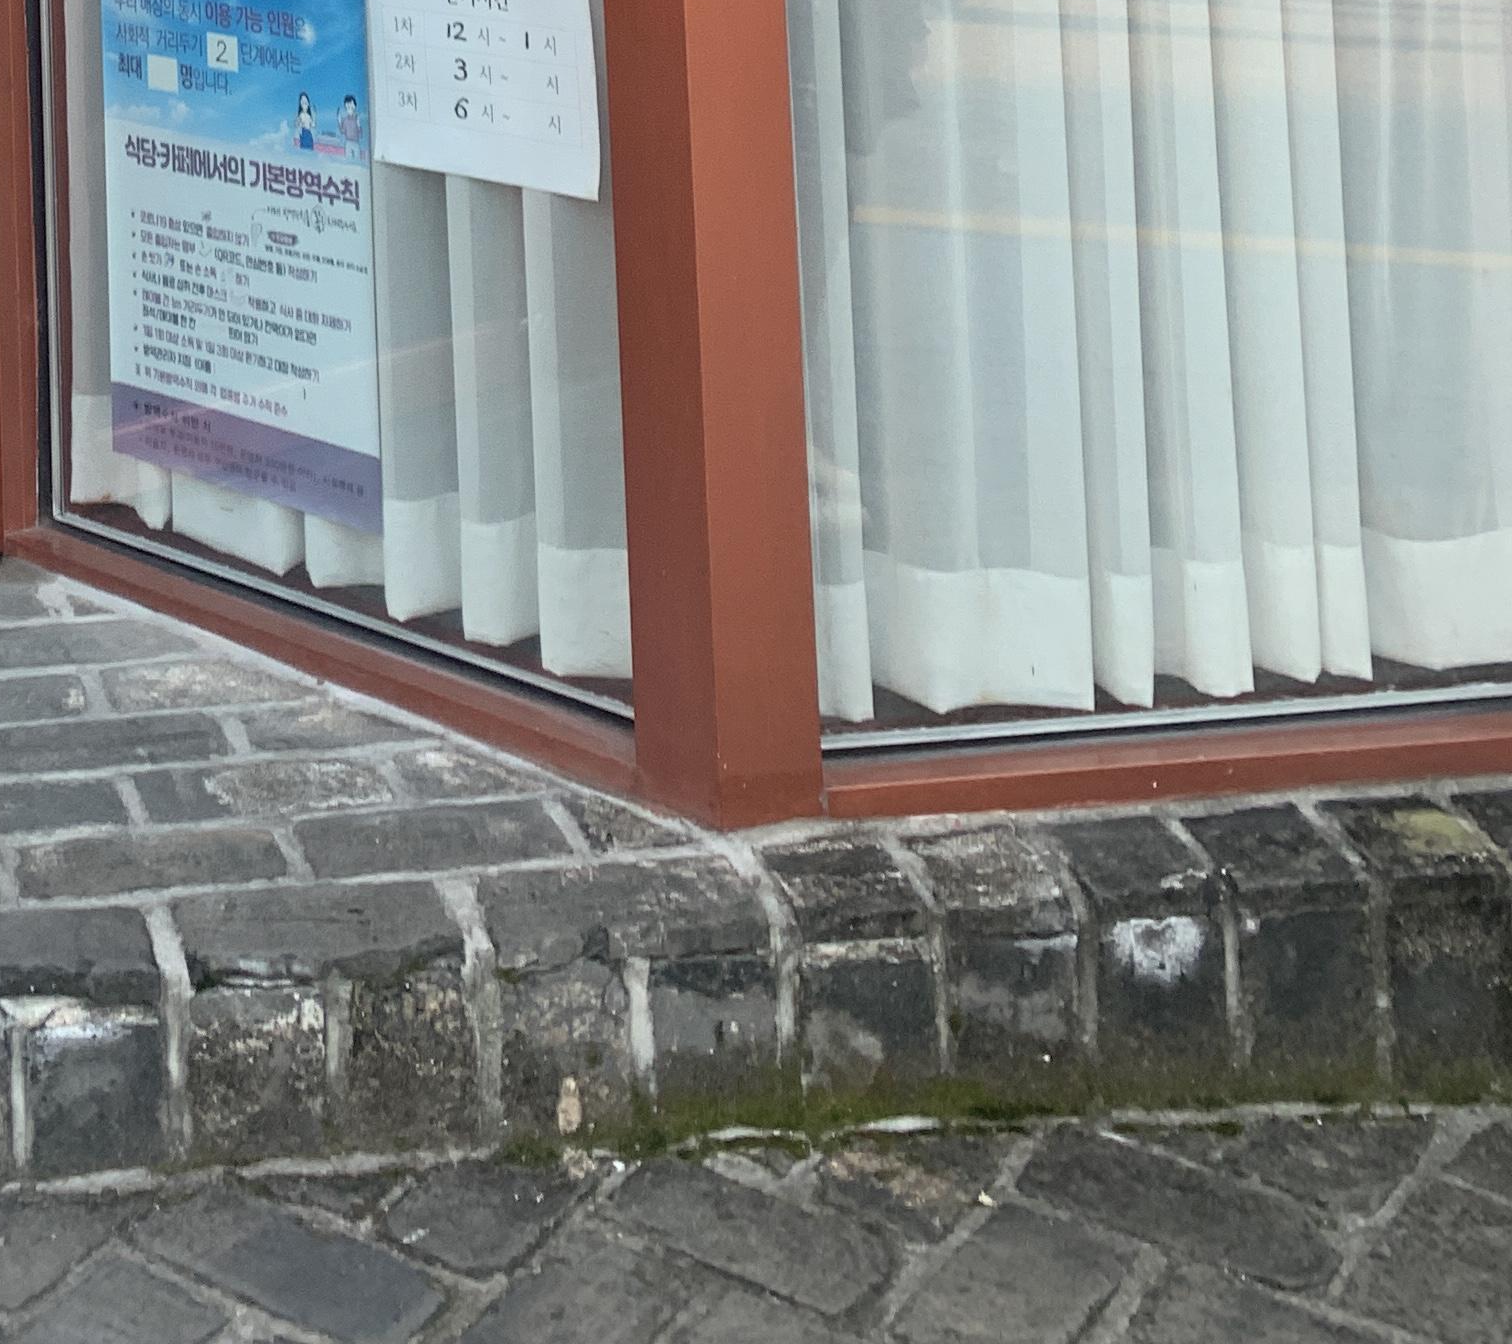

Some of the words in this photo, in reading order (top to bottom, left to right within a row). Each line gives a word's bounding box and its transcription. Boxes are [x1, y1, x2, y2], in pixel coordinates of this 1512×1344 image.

[205, 0, 233, 29] 이용
[236, 5, 264, 34] 가능
[156, 28, 203, 58] 거리두기
[216, 38, 229, 65] 2
[446, 21, 468, 42] 12
[478, 25, 490, 47] 시
[524, 30, 530, 50] 1
[544, 35, 557, 57] 시
[118, 52, 143, 81] 최대
[453, 57, 468, 82] 3
[480, 64, 492, 85] 시
[546, 75, 559, 96] 시
[454, 97, 469, 120] 6
[481, 104, 494, 124] 시
[548, 115, 561, 135] 시
[249, 159, 361, 211] 기본방역수칙
